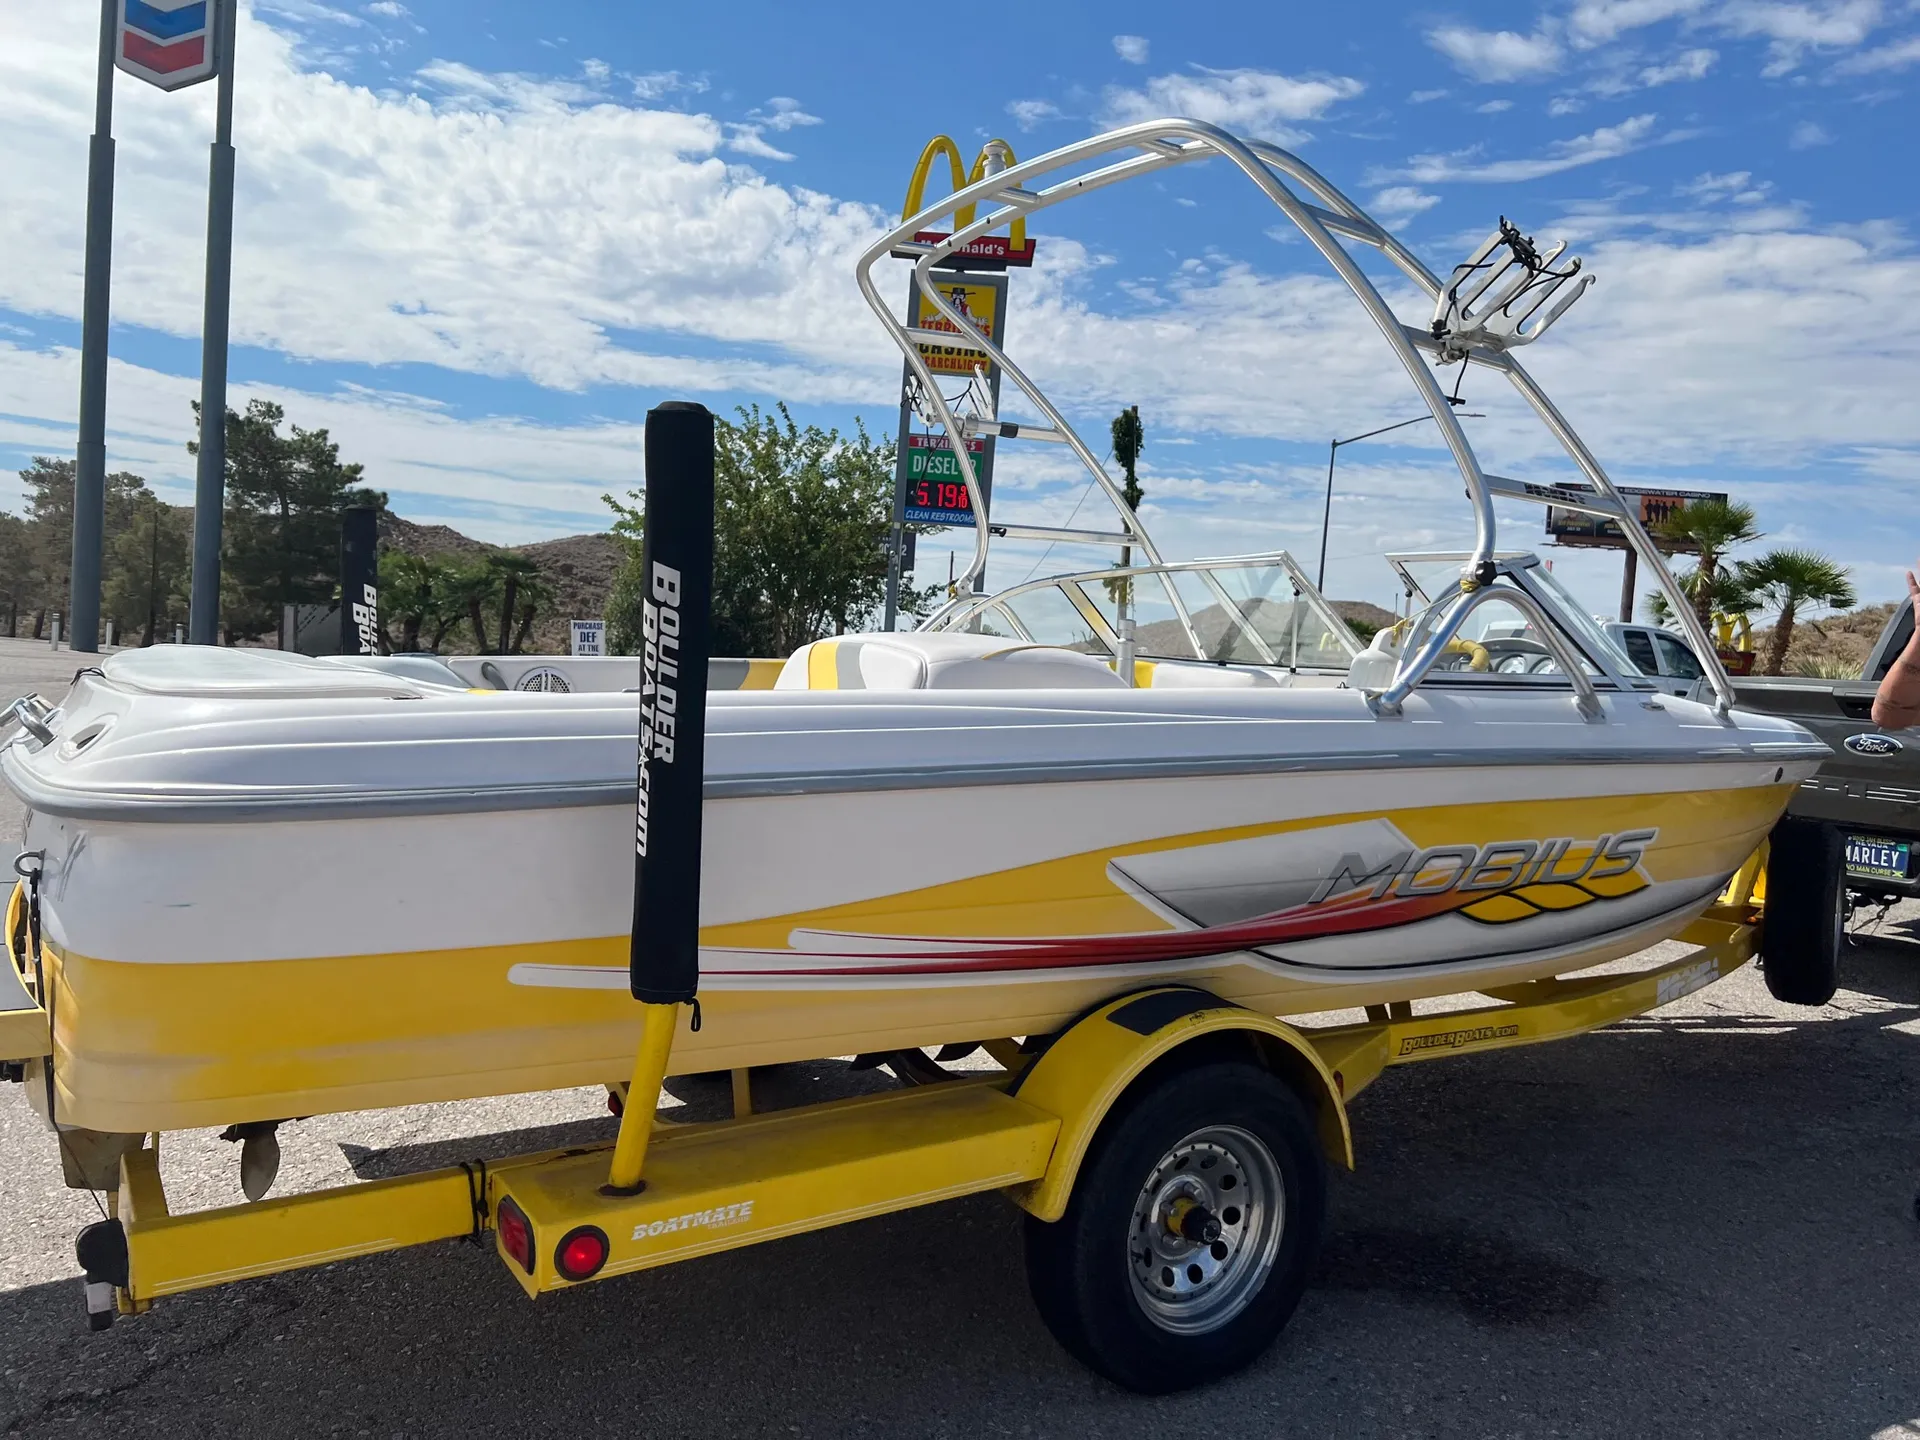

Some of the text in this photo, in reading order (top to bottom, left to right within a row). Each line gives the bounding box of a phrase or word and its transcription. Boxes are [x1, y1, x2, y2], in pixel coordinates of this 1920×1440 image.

[920, 320, 990, 337] TERRI'S
[922, 356, 987, 371] EARCHLIGHT
[917, 437, 977, 450] TERRI'S
[913, 455, 958, 475] DIESEL
[1624, 488, 1678, 497] EDGEWATER
[1679, 491, 1711, 499] CASINO
[906, 510, 976, 523] CLEAN RESTROOMS
[573, 622, 603, 630] PURCHASE
[580, 632, 597, 643] DEF
[578, 644, 599, 653] AT THE
[651, 560, 681, 765] BOULDER
[1856, 737, 1889, 752] Ford
[1308, 828, 1657, 903] MOBIUS
[1856, 865, 1870, 873] MAN
[1871, 867, 1892, 876] CURSE
[631, 1200, 755, 1241] BOATMATE
